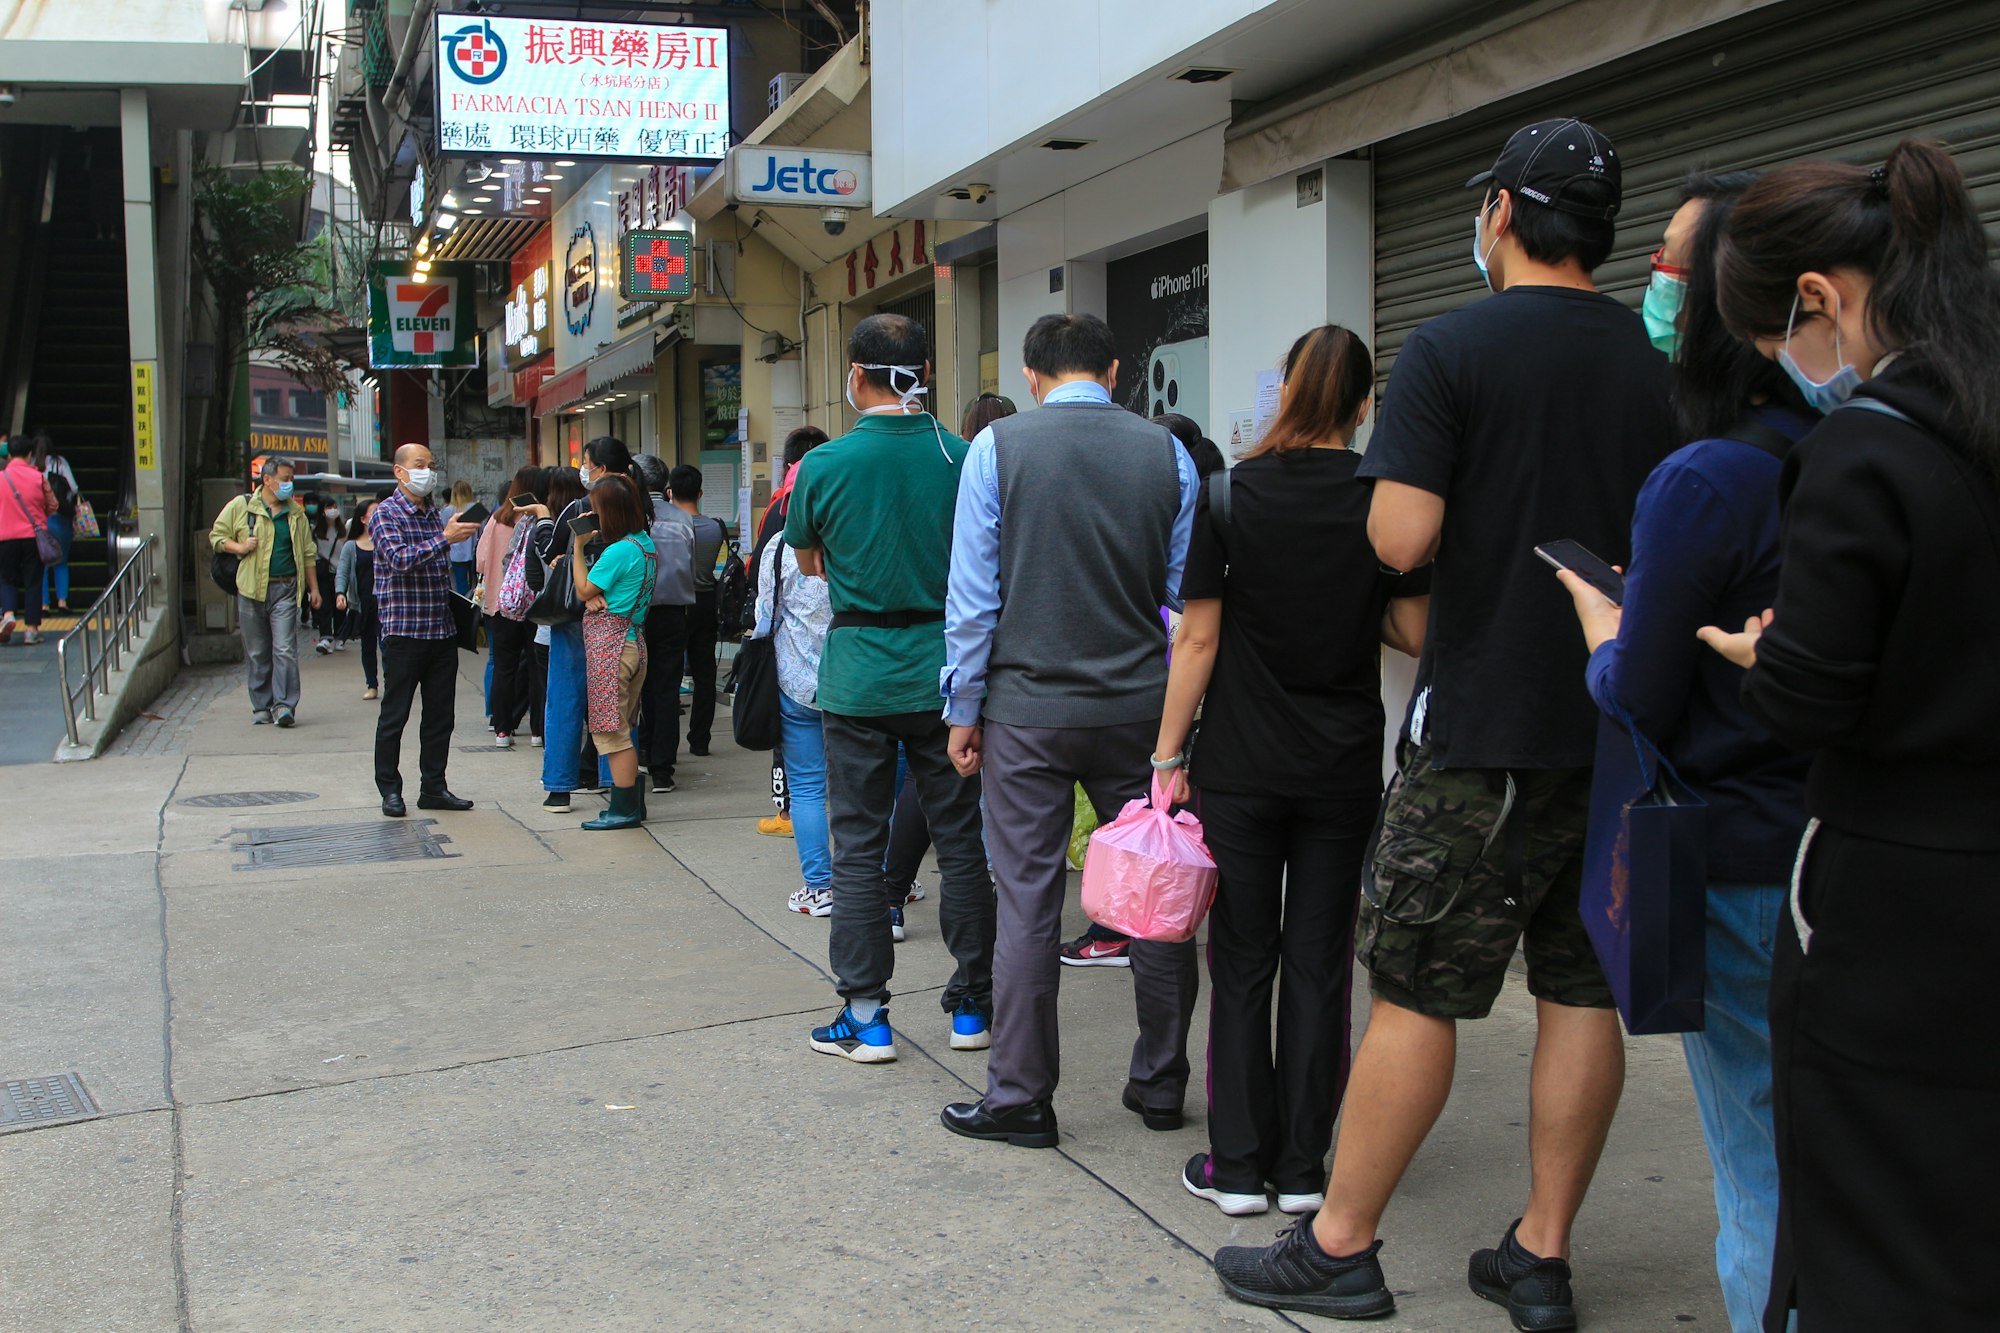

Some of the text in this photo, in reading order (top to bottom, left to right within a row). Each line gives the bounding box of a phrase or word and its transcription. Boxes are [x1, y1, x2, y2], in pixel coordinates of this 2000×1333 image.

[524, 25, 719, 70] 振興藥房II
[452, 93, 718, 120] FARMACIA TSAN HENG II
[509, 125, 619, 152] 環球西藥
[1520, 186, 1551, 204] DODGERS
[1158, 275, 1191, 298] iPhone
[1191, 265, 1200, 289] 11
[262, 433, 299, 452] DELTA
[304, 436, 329, 453] ASIA
